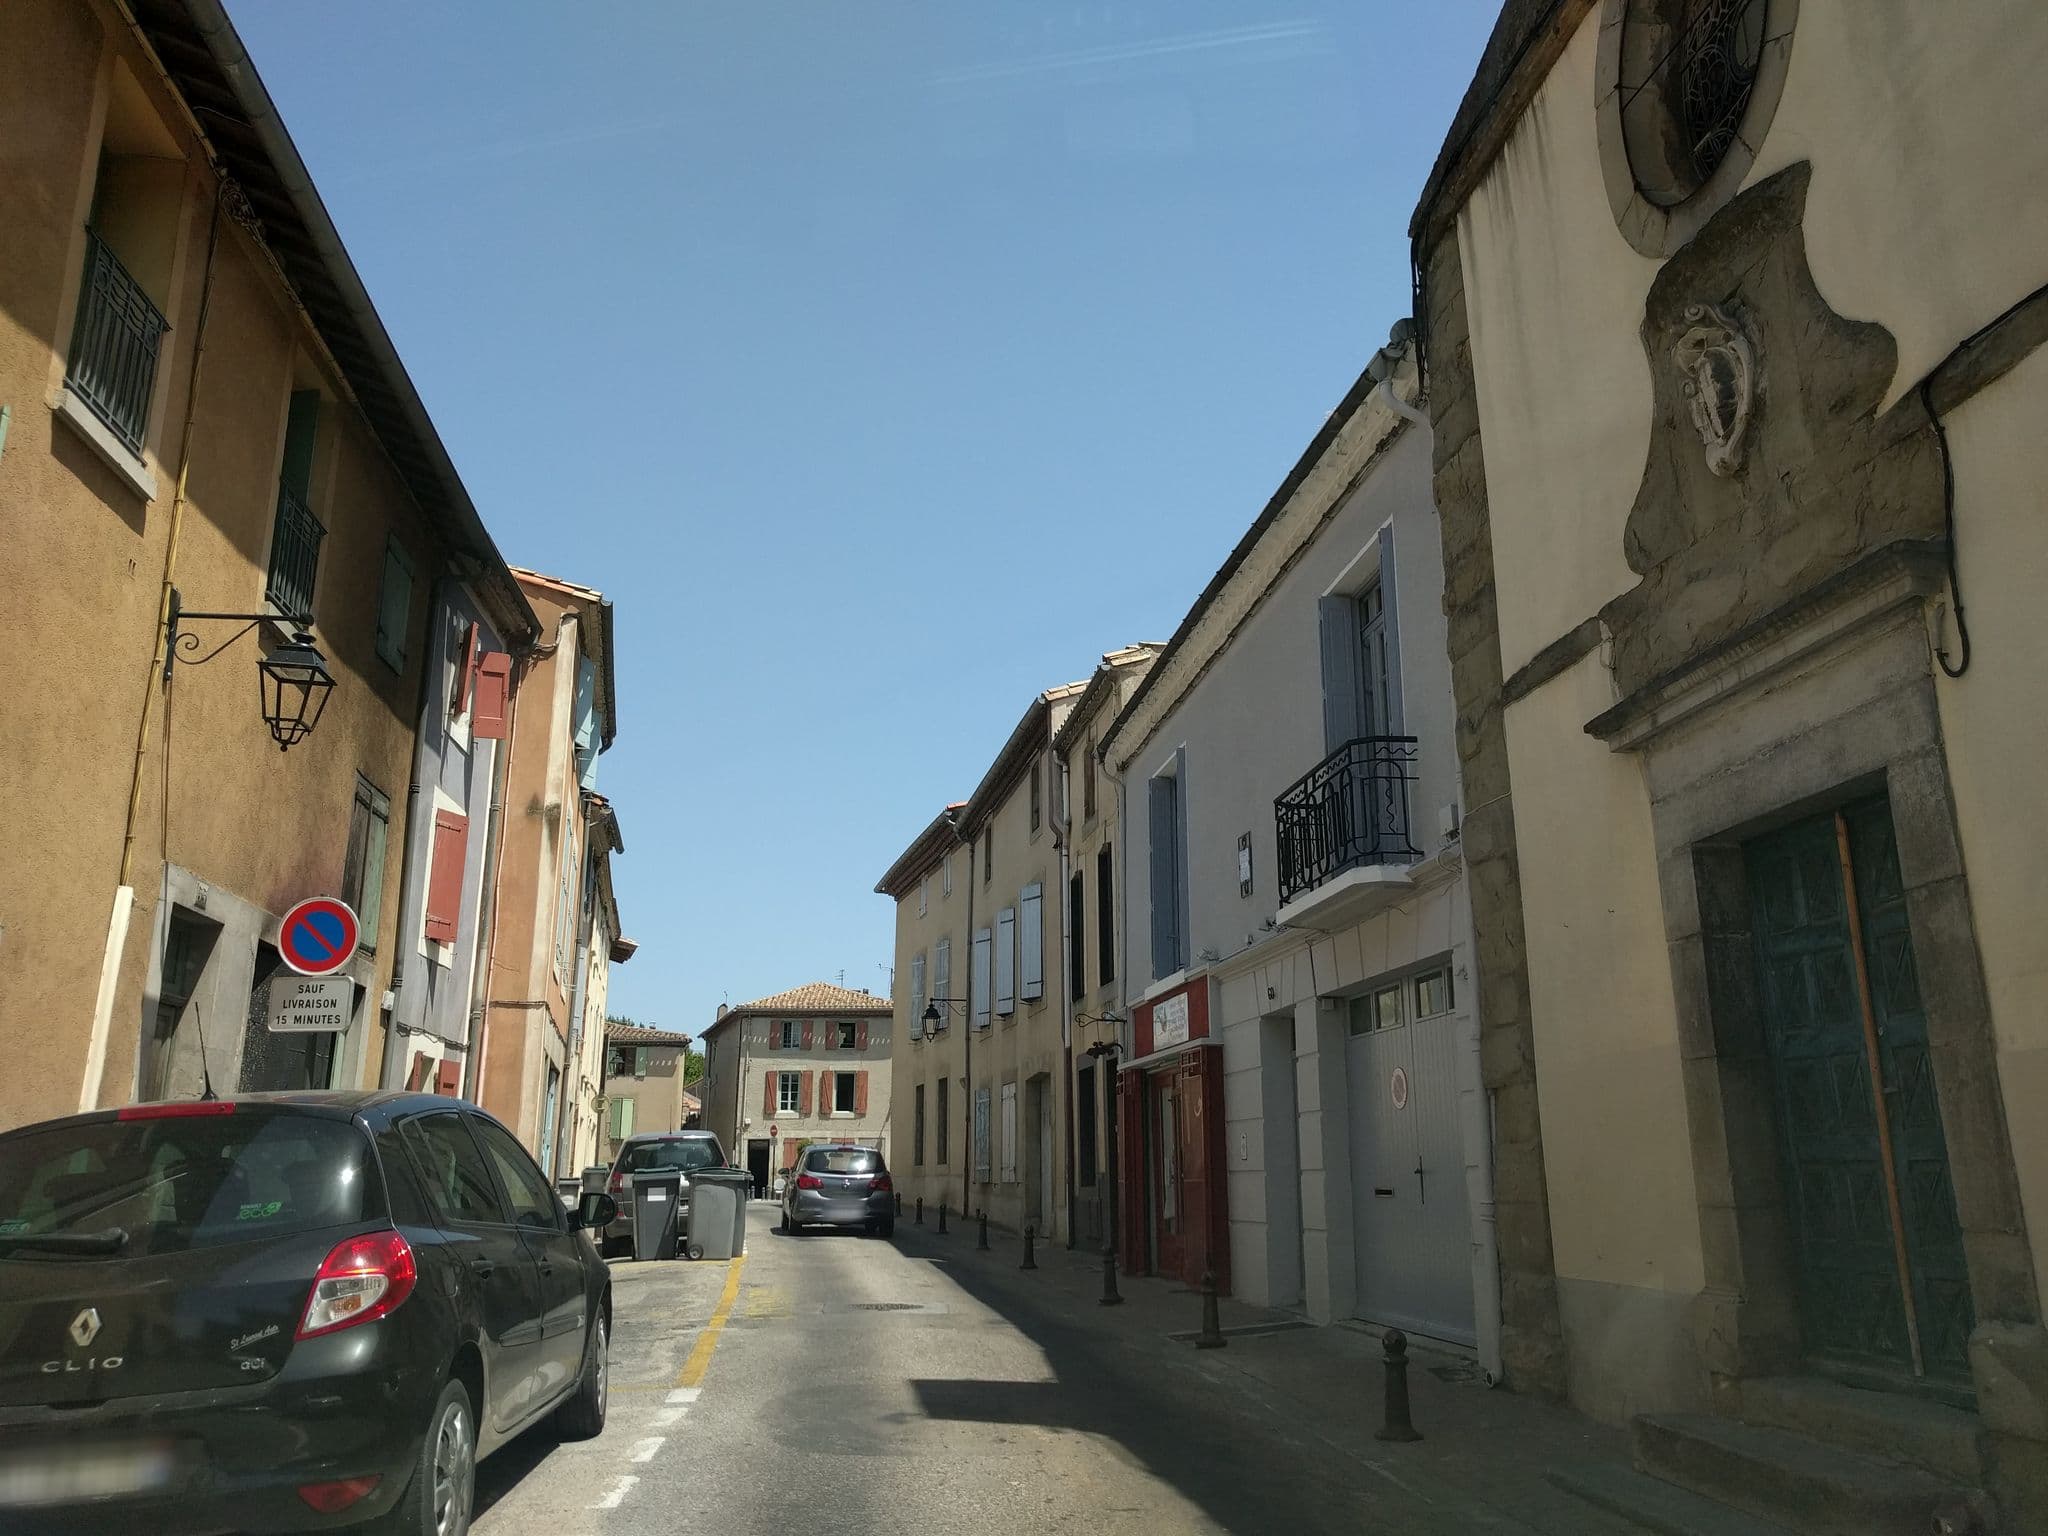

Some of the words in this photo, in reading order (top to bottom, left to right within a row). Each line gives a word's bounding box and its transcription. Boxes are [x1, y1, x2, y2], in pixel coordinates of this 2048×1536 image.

[298, 984, 325, 994] SAUF
[282, 999, 337, 1009] LIVRAISON
[276, 1015, 287, 1025] 15
[293, 1014, 341, 1025] MINUTES
[41, 1357, 123, 1373] CLIO
